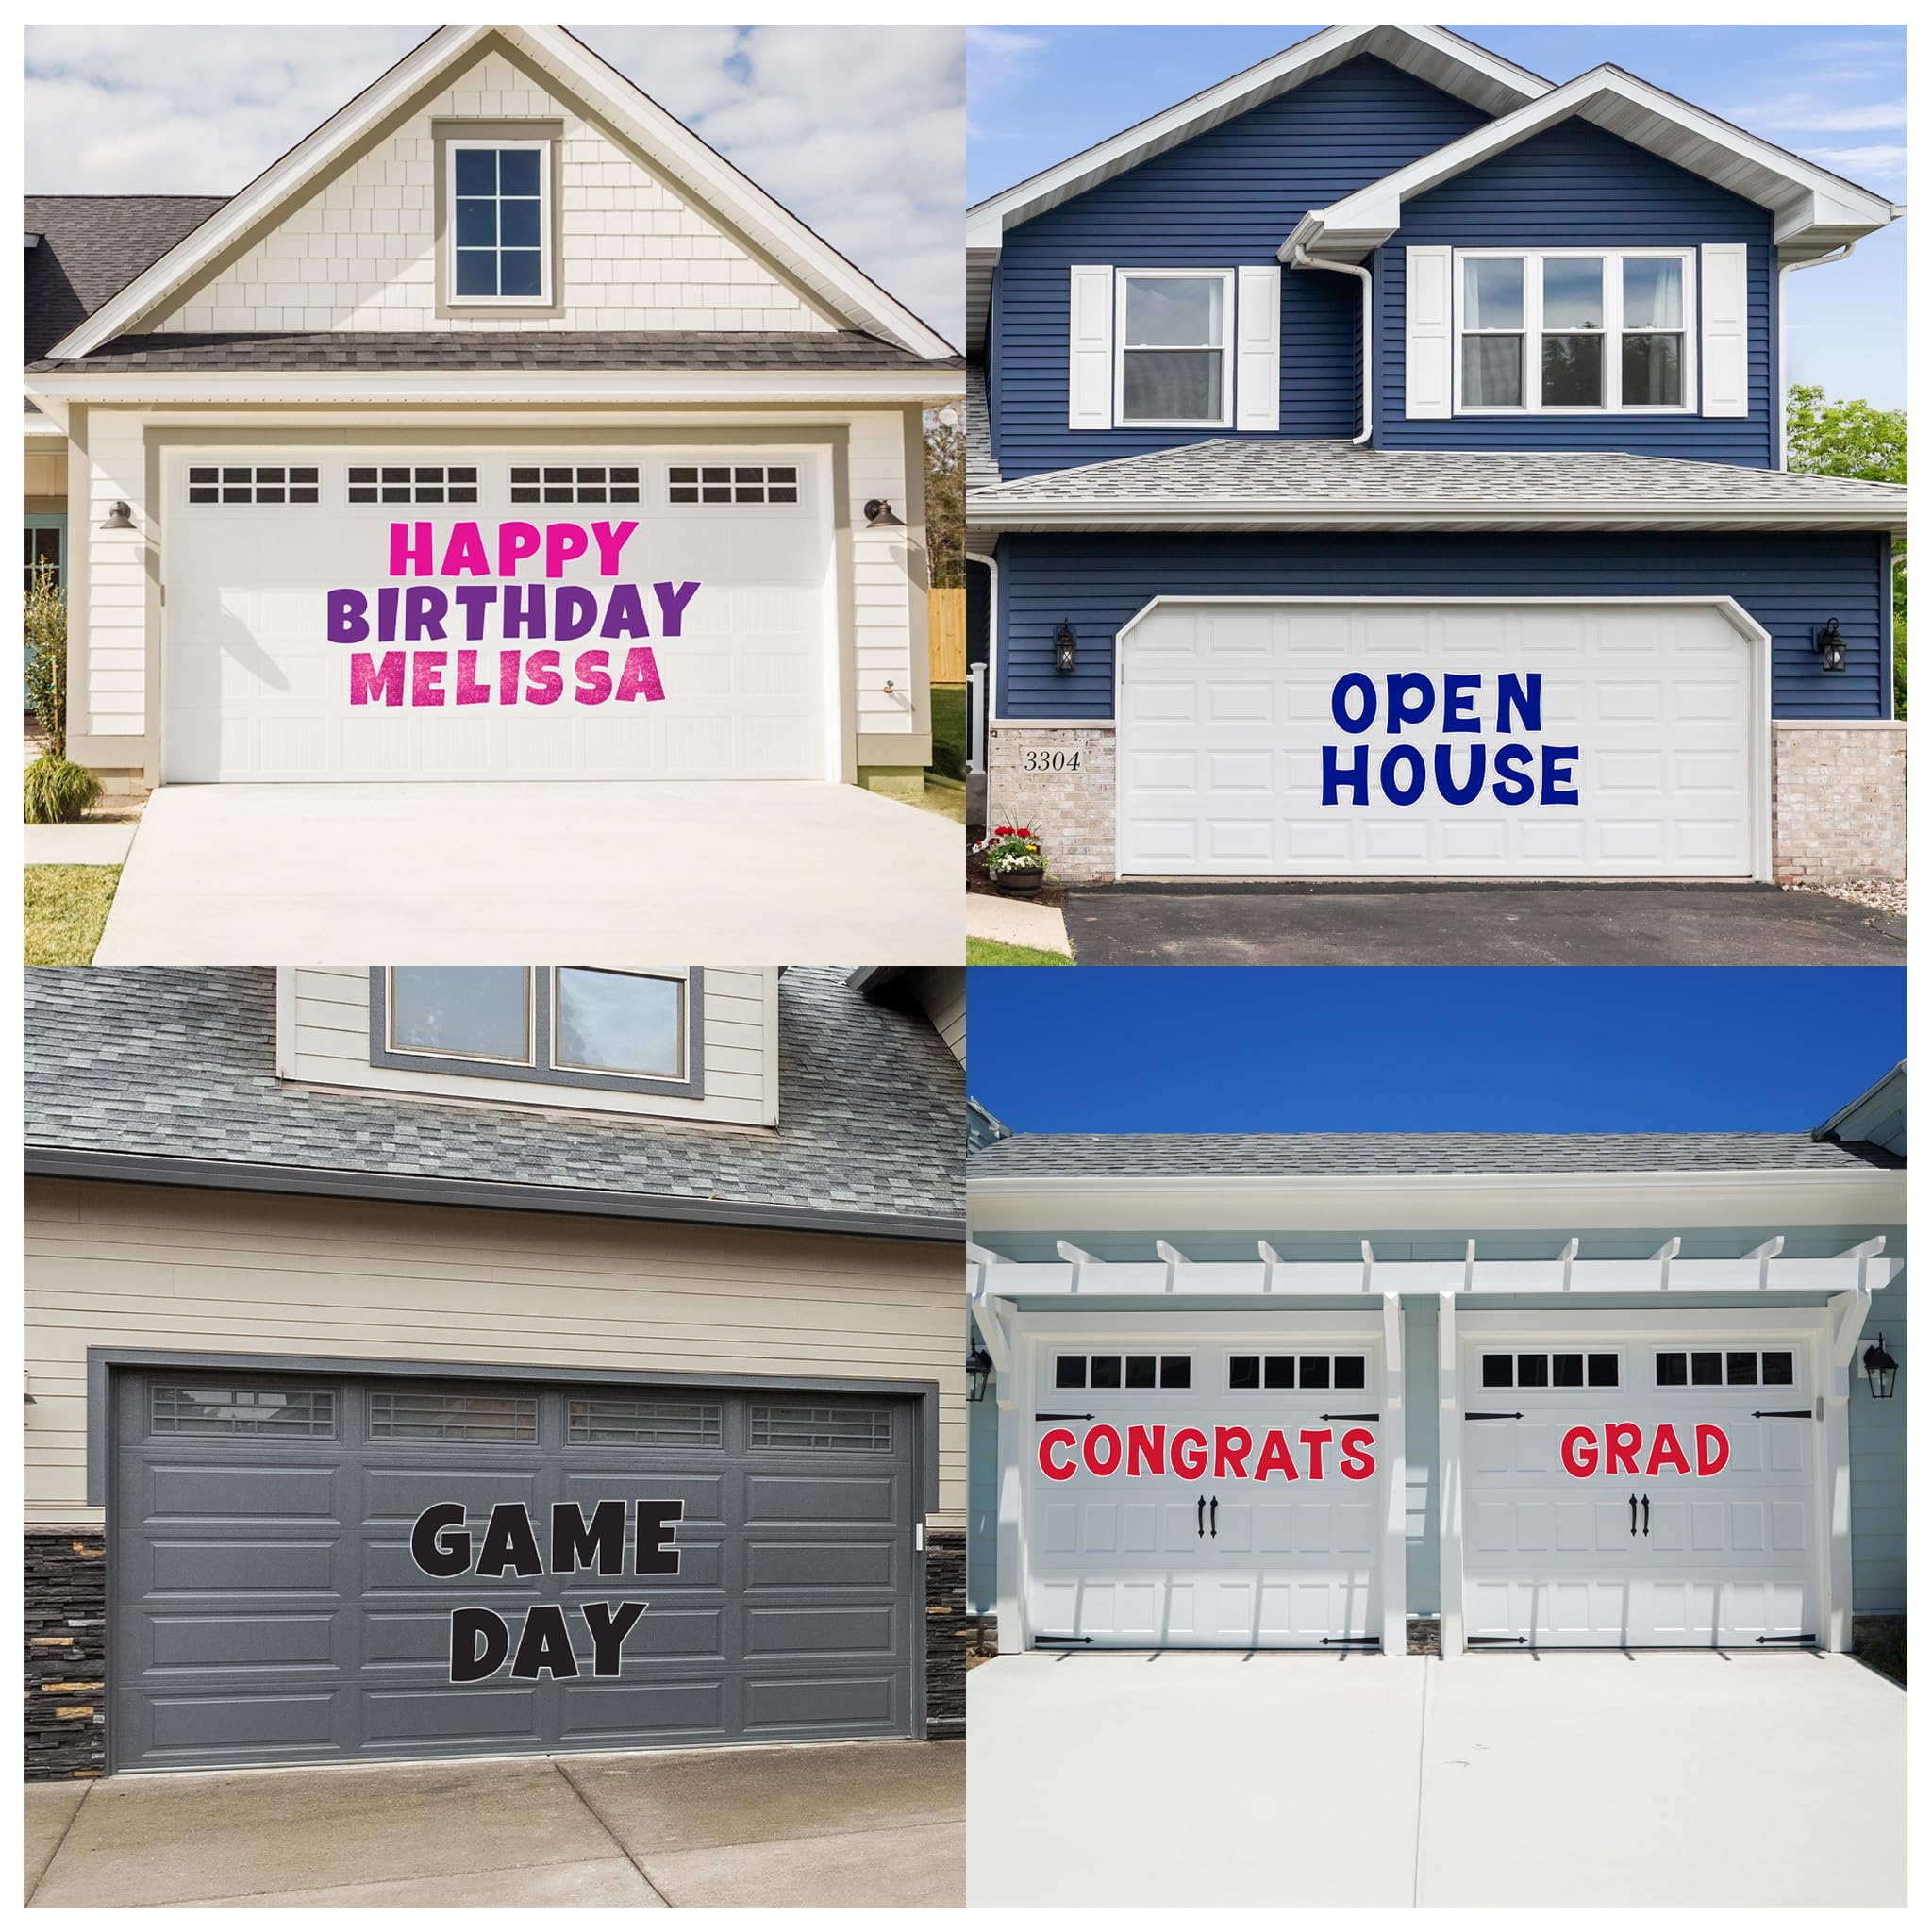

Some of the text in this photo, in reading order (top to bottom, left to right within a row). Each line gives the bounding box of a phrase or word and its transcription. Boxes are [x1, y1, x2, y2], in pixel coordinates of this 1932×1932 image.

[388, 520, 641, 579] HAPPY
[326, 581, 701, 644] BIRTHDAY
[349, 647, 666, 708] MELISSA
[1331, 672, 1543, 735] OPEN
[1024, 750, 1081, 772] 3304
[1321, 743, 1580, 807] HOUSE
[1039, 1424, 1376, 1482] CONGRATS
[1560, 1422, 1731, 1478] GRAD
[411, 1500, 683, 1576] GAME
[450, 1603, 648, 1682] DAY
